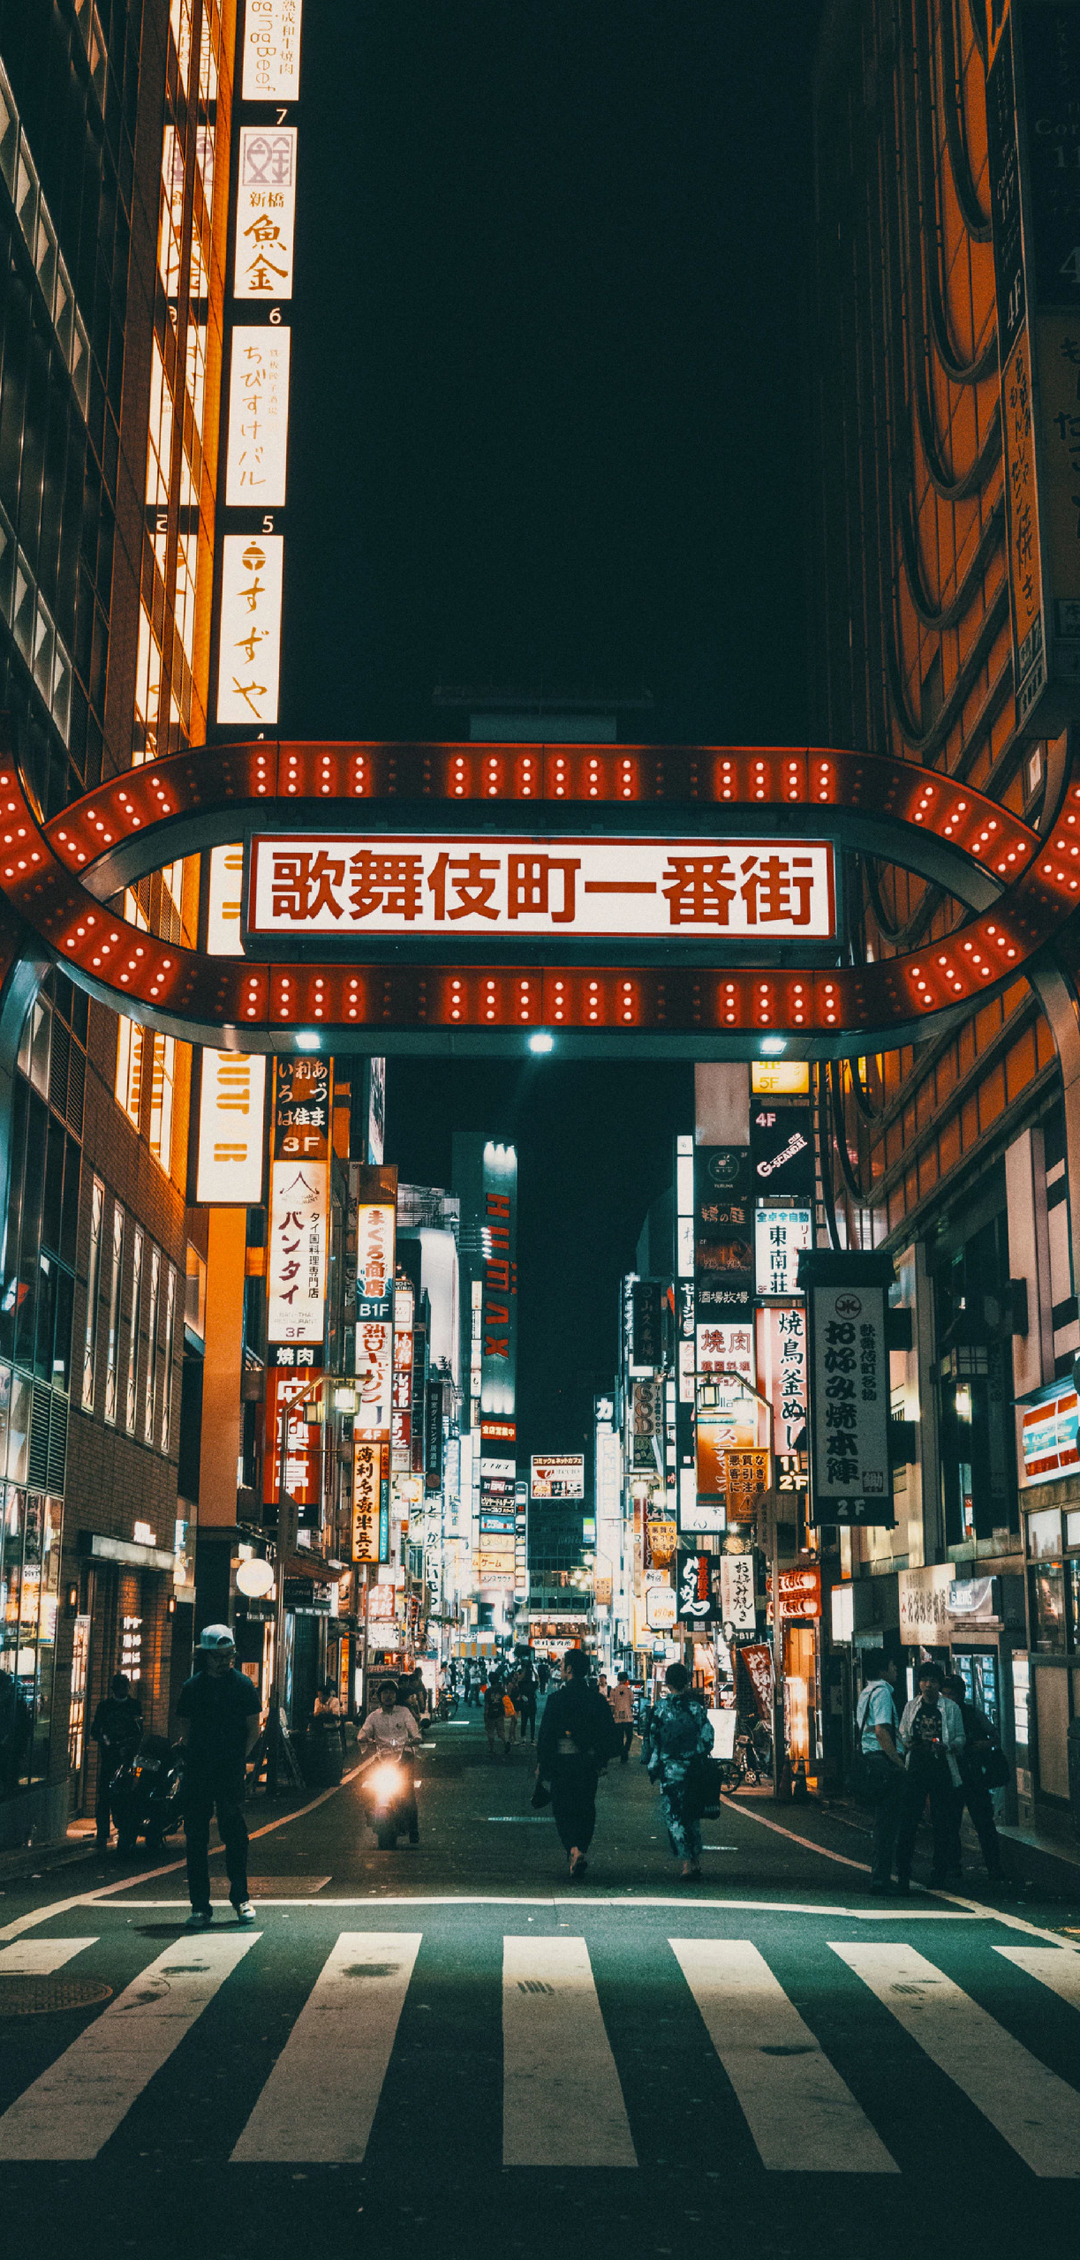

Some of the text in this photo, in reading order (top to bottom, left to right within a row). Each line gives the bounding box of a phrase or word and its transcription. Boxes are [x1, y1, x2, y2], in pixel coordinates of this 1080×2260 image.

[276, 109, 288, 124] 7
[249, 191, 284, 208] 新橋
[243, 213, 289, 291] 魚金
[269, 308, 281, 324] 6
[238, 345, 266, 486] ちびすけバル
[262, 515, 274, 533] 5
[231, 576, 269, 719] すずや
[271, 849, 815, 926] 歌舞伎町一番街
[759, 1076, 779, 1089] 5F
[756, 1113, 777, 1127] 4F
[283, 1137, 320, 1152] 3F
[756, 1211, 809, 1223] 全卓全自動
[279, 1211, 305, 1305] バンタイ
[307, 1212, 321, 1299] タイ国料理専門店
[365, 1209, 386, 1299] まぐろ商店
[769, 1225, 788, 1293] 東南荘
[698, 1291, 749, 1304] 酒場牧場
[757, 1285, 768, 1294] 3F
[359, 1303, 389, 1317] B1F
[285, 1328, 306, 1338] 3F
[701, 1329, 751, 1353] 焼肉
[277, 1347, 314, 1366] 焼肉
[860, 1323, 878, 1402] 歌舞伎町名物
[701, 1361, 751, 1372] 韓国料理
[779, 1311, 805, 1451] 焼鳥釜めし
[825, 1320, 859, 1486] お好み焼本陣
[362, 1430, 382, 1441] 4F
[729, 1454, 765, 1466] 悪質な
[729, 1468, 765, 1480] 客引き
[729, 1481, 767, 1493] に注意
[837, 1500, 866, 1516] 2F
[738, 1632, 755, 1640] B1F
